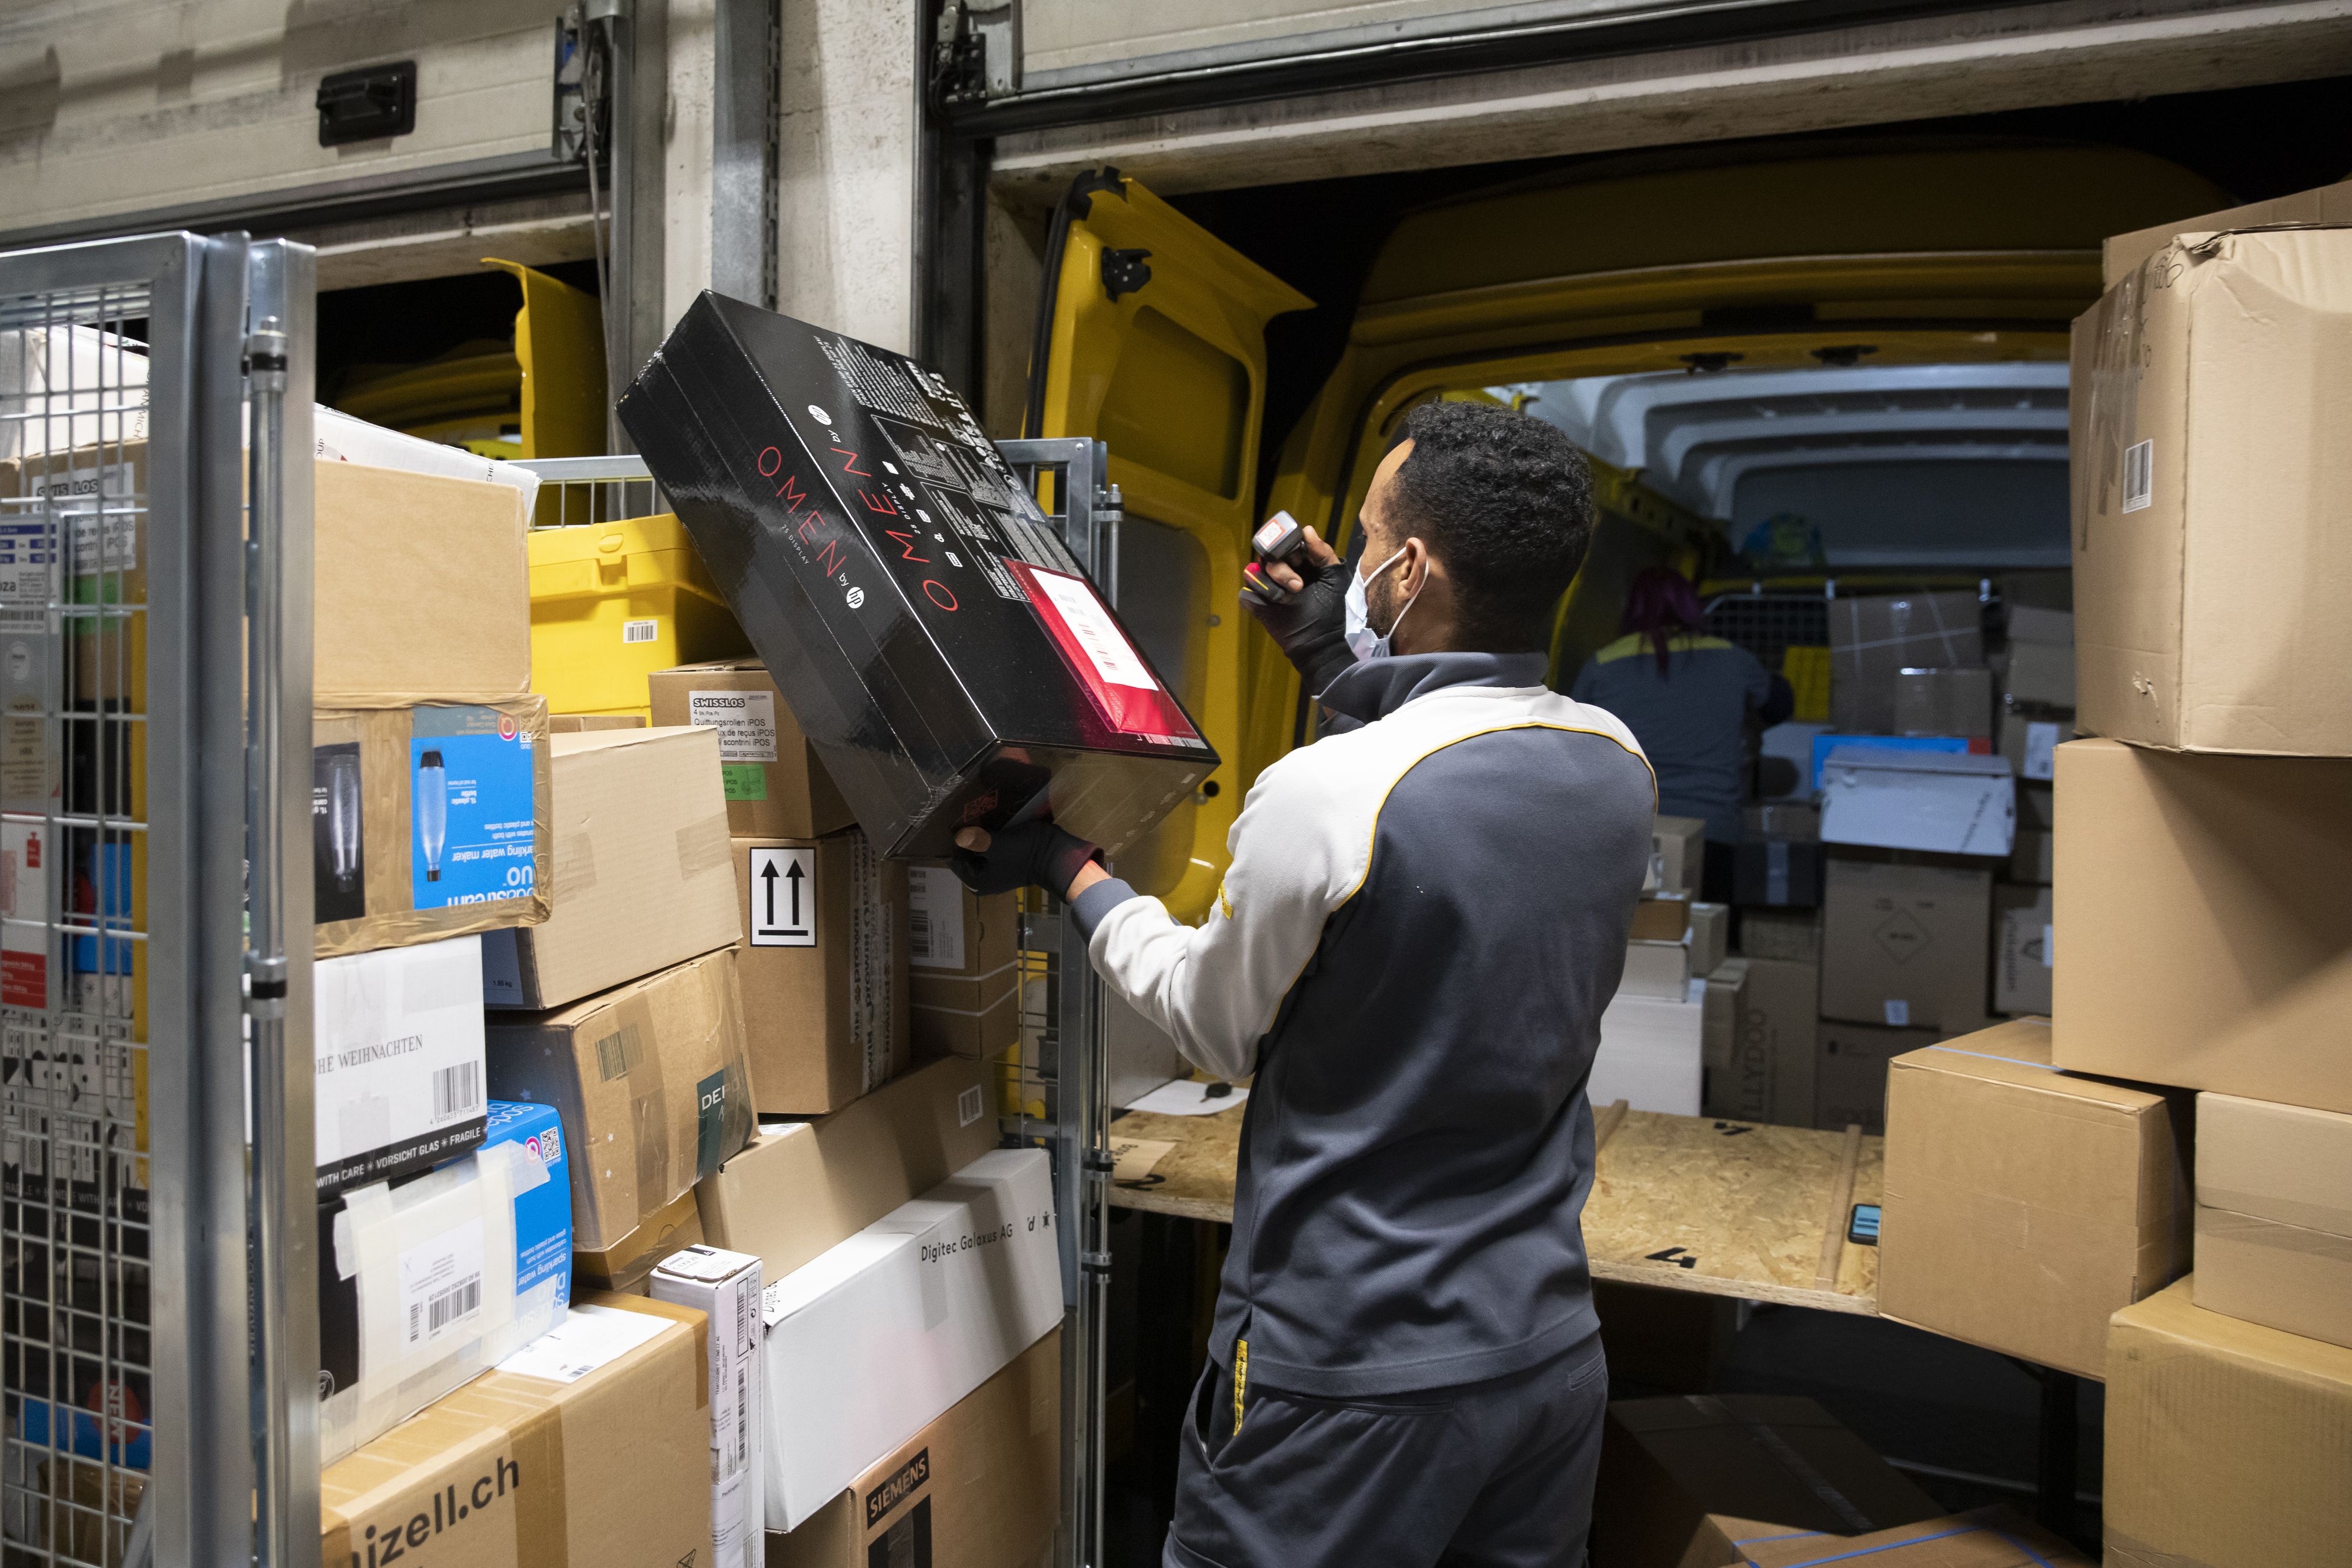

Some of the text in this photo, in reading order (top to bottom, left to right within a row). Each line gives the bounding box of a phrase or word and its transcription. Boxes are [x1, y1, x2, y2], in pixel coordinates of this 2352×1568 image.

[828, 430, 841, 443] by
[882, 483, 911, 520] DISPLAY
[758, 446, 864, 609] OMEN by hp
[781, 524, 810, 564] 25 DISPLAY
[830, 447, 958, 611] OMEN
[693, 698, 746, 708] SWISSLOS
[694, 718, 745, 727] Quittungsrollen
[503, 821, 519, 830] plastic
[452, 845, 535, 862] arkling water maker
[503, 865, 533, 887] UO
[315, 1034, 423, 1075] HE WEIHNACHTEN
[317, 1126, 481, 1188] WITH CARE VORSICHT GLAS FRAGILE
[921, 1223, 1013, 1263] Digitec Galaxus AG
[517, 1253, 567, 1287] sparkling water
[870, 1457, 927, 1519] SIEMENS
